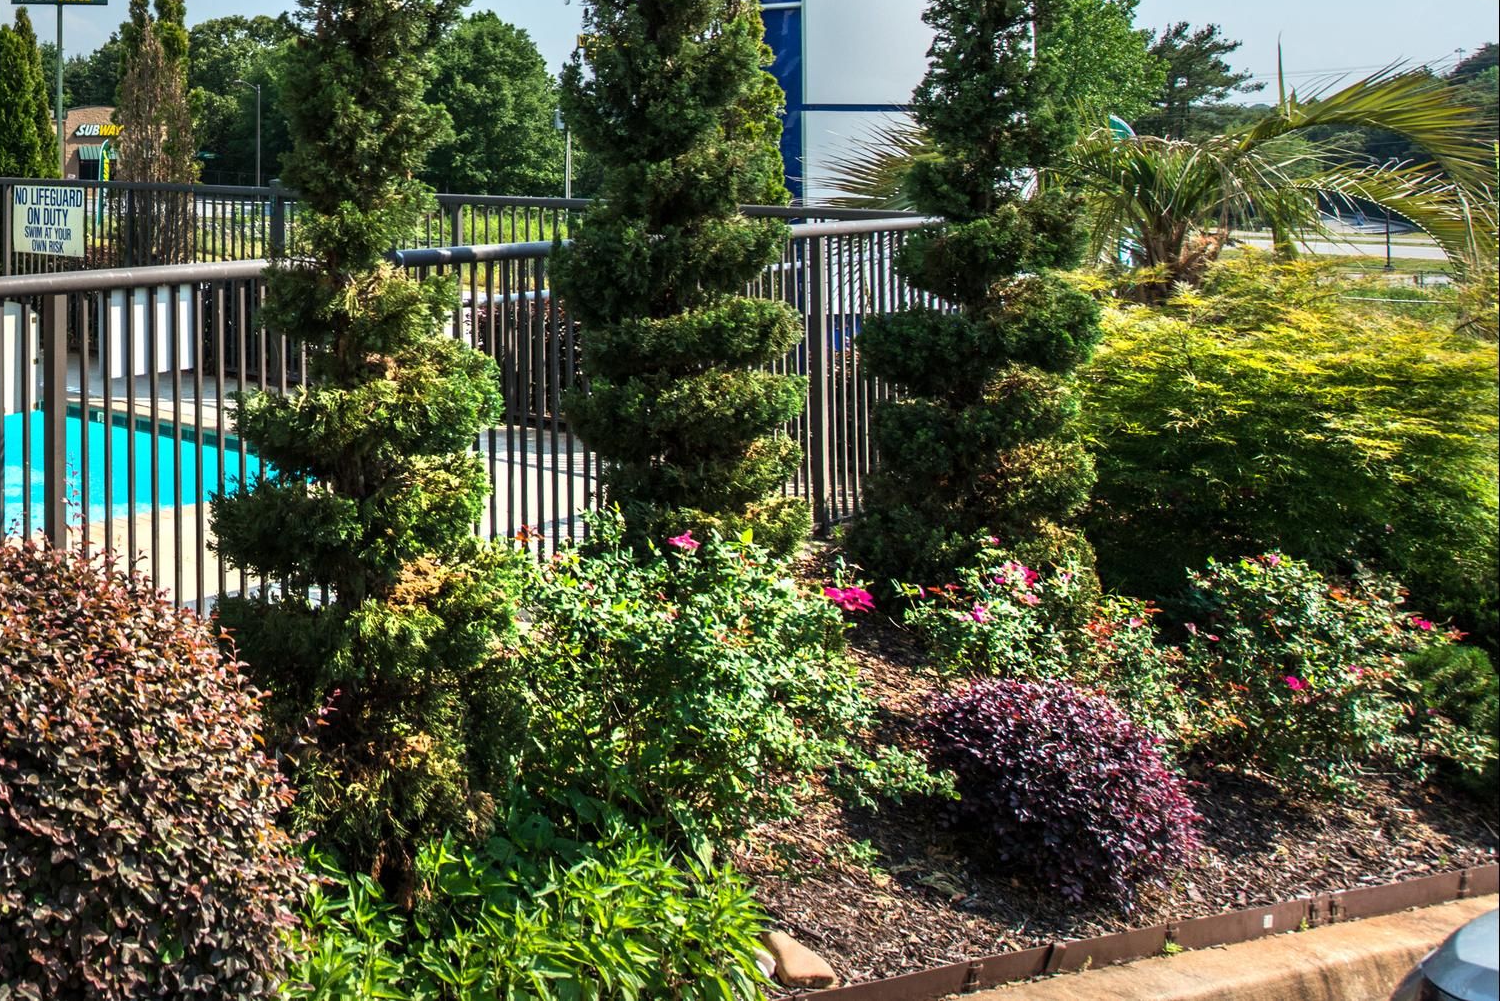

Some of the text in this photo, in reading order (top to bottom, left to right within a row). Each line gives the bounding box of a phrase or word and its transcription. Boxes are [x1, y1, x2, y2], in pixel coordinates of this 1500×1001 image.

[76, 124, 124, 136] SUBWAY
[15, 187, 83, 207] NO LIFEGUARD
[27, 207, 69, 226] ON DUTY
[24, 226, 71, 240] SWIM AT YOUR
[31, 239, 64, 254] OWN RISK
